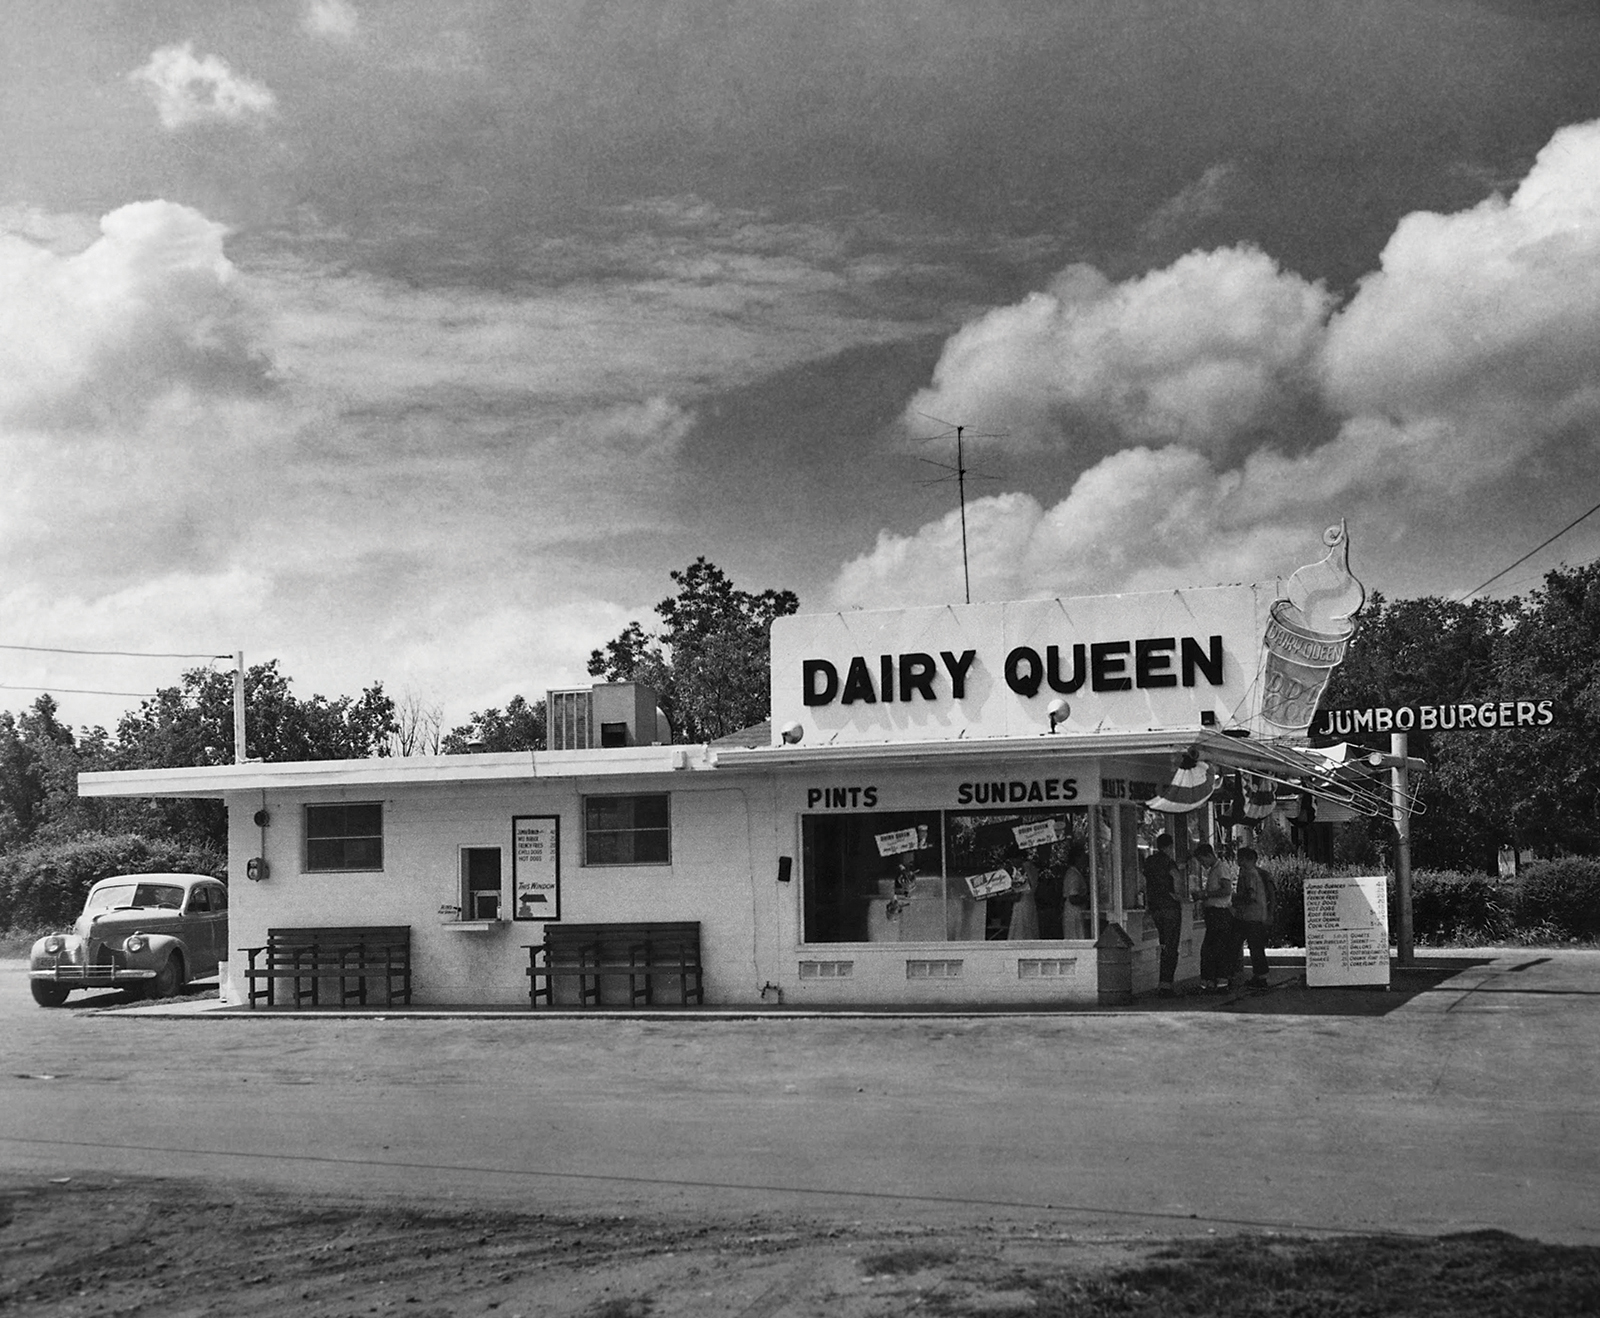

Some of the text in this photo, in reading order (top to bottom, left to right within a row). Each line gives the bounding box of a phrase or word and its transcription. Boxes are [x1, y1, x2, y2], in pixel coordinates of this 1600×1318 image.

[1268, 622, 1341, 662] DAIRY QUEEN
[802, 635, 1223, 706] DAIRY QUEEN
[1319, 706, 1415, 736] JUMBO
[1420, 700, 1554, 730] BURGERS
[807, 786, 878, 808] PINTS
[957, 779, 1078, 804] SUNDAES
